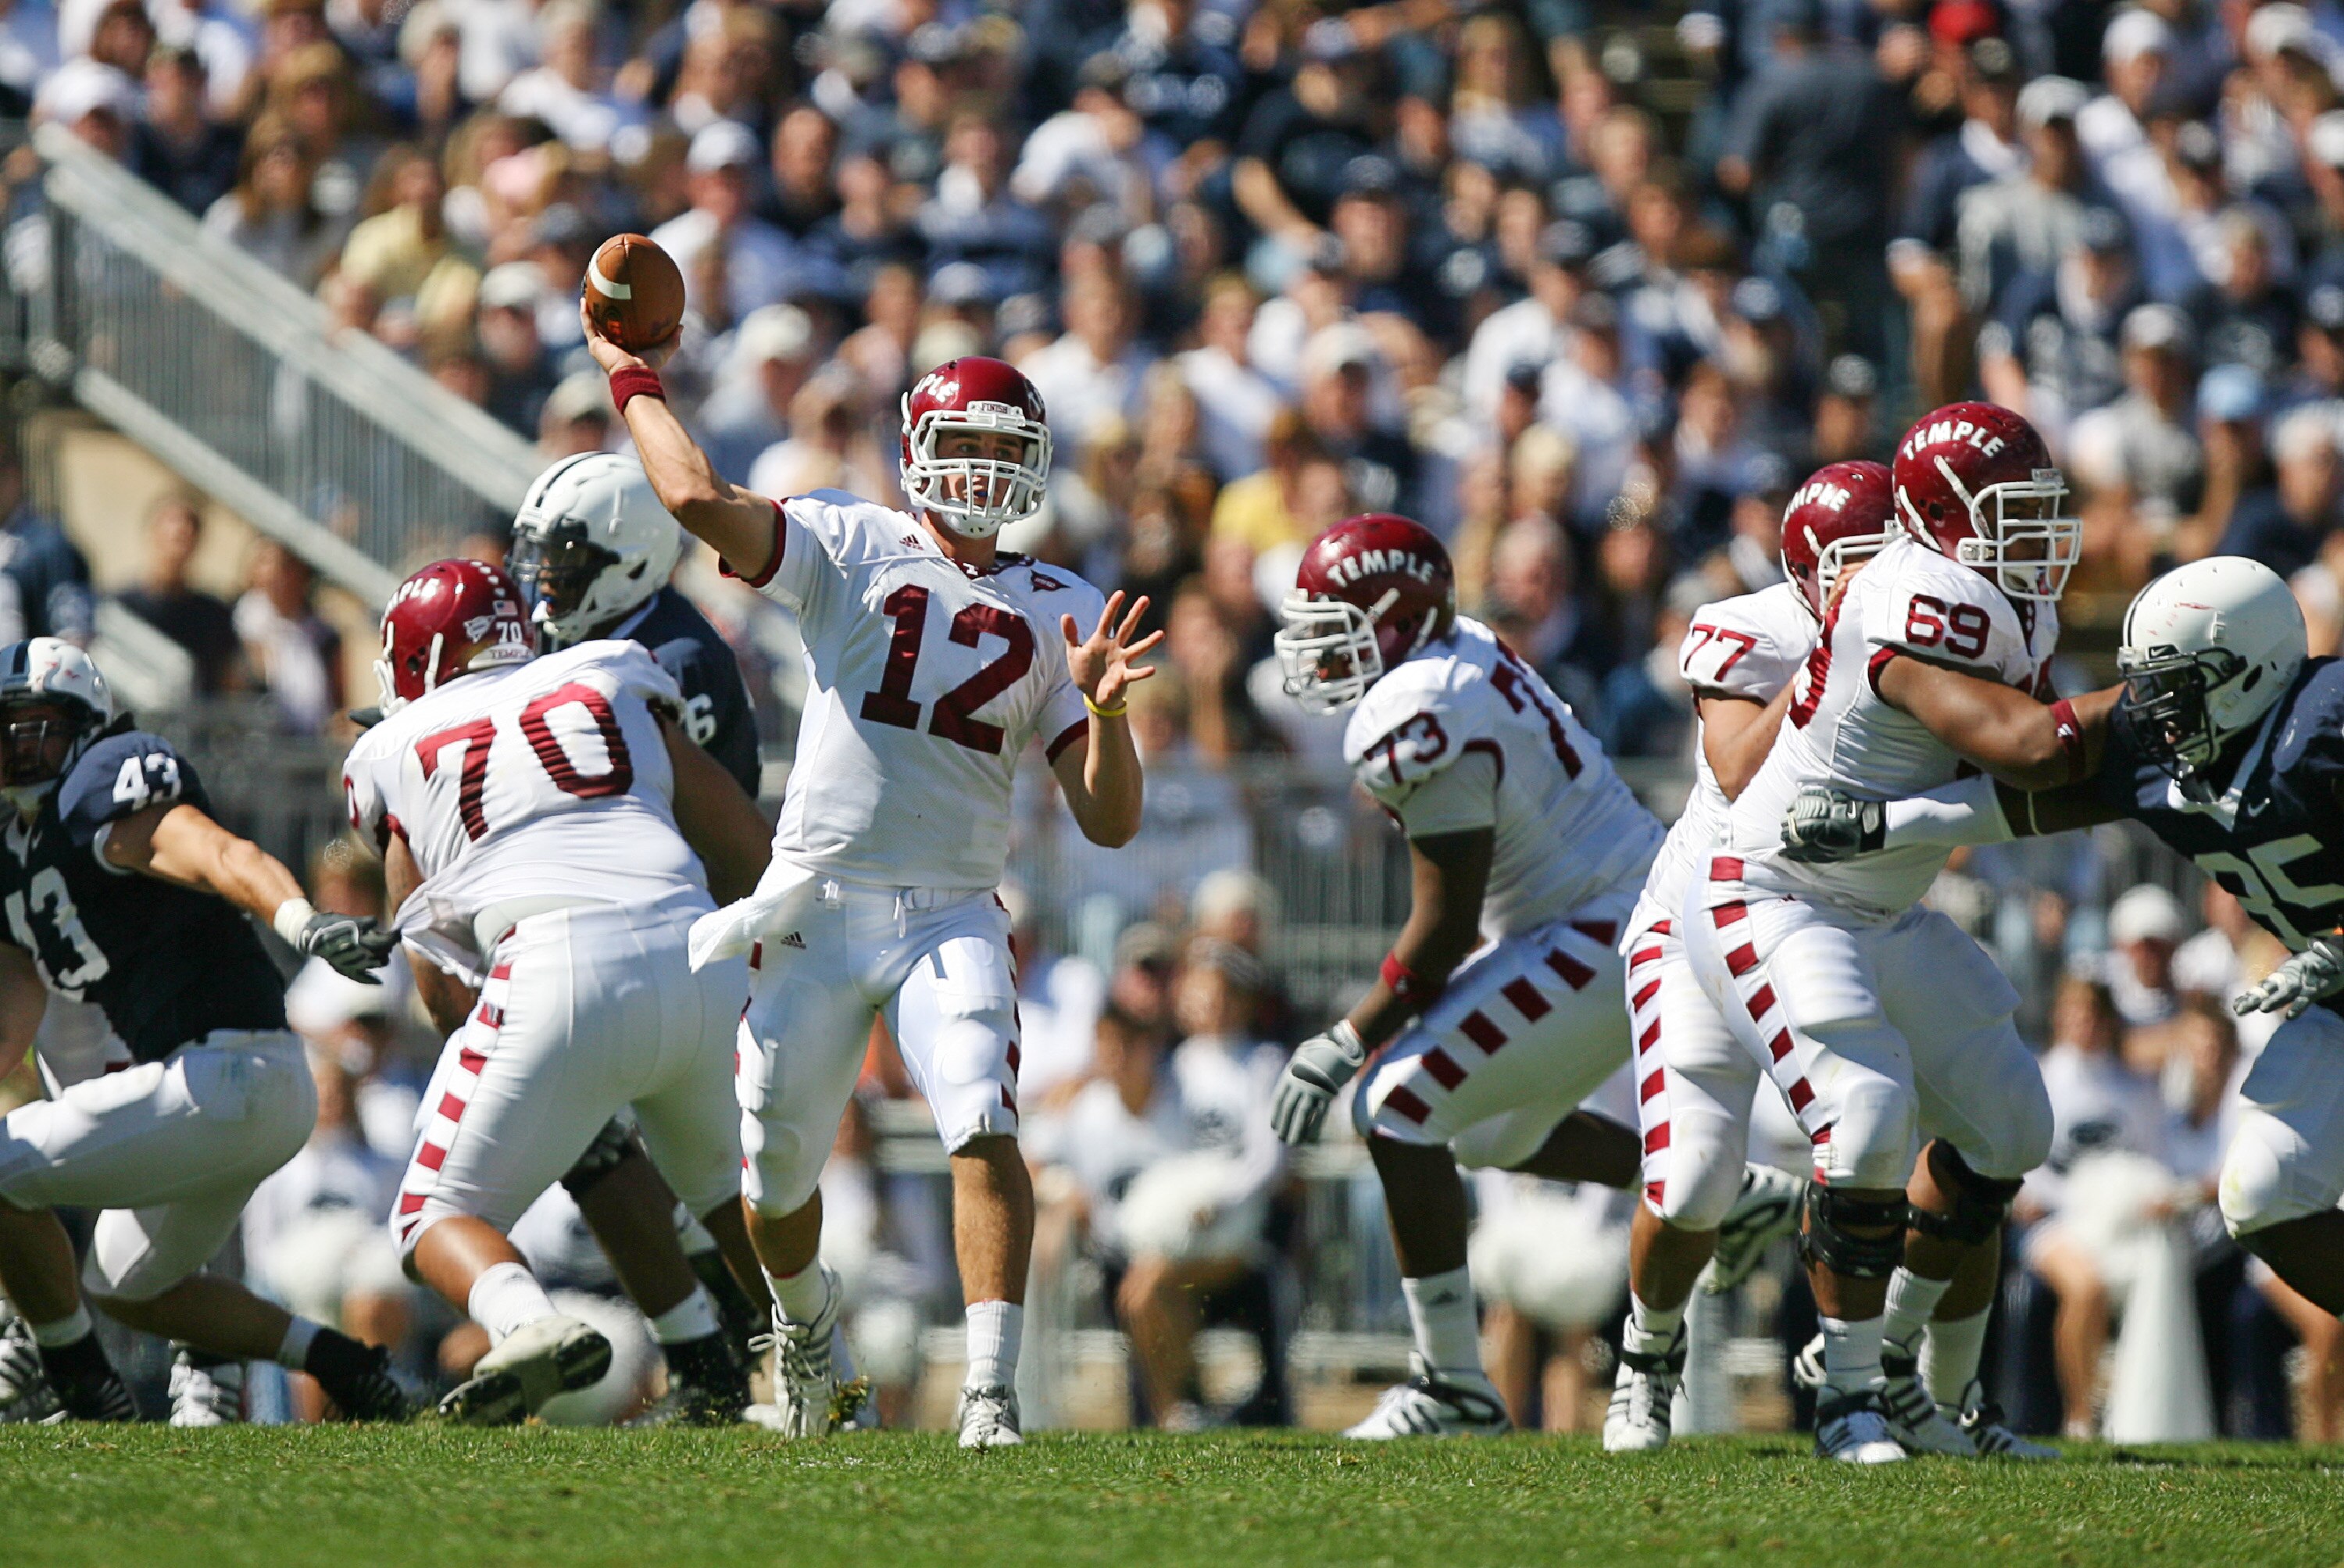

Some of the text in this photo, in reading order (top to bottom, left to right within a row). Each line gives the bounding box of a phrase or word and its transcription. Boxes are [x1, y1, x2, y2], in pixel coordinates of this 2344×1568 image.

[1903, 420, 2006, 461] TEMPLE
[1783, 482, 1852, 522] MPLE
[1327, 548, 1435, 587] TEMPLE
[495, 622, 523, 643] 70
[1683, 623, 1758, 682] 77
[1906, 593, 1991, 660] 69
[859, 584, 1034, 755] 12
[685, 692, 716, 747] 6
[1363, 712, 1449, 784] 73
[112, 752, 181, 810] 43
[415, 681, 633, 842] 70
